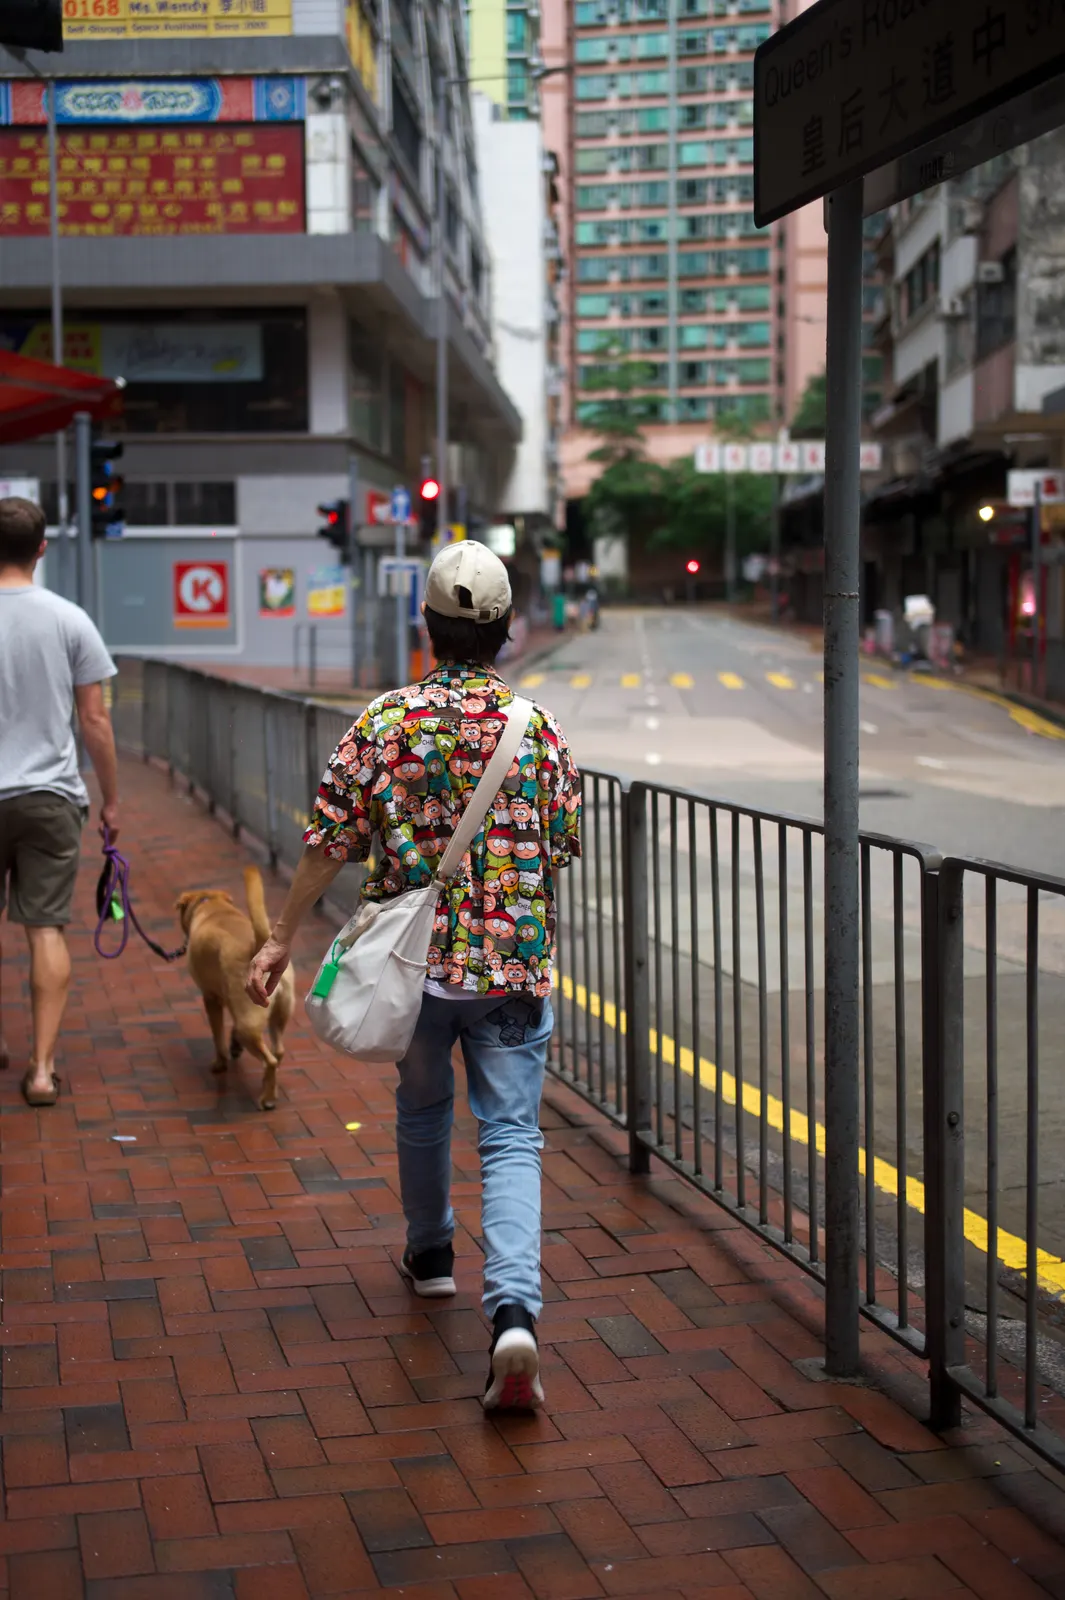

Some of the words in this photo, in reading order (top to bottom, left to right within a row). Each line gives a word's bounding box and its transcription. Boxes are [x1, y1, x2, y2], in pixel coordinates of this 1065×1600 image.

[765, 19, 852, 107] Queen's
[862, 0, 931, 47] Roa
[801, 5, 1007, 177] 皇后大道中
